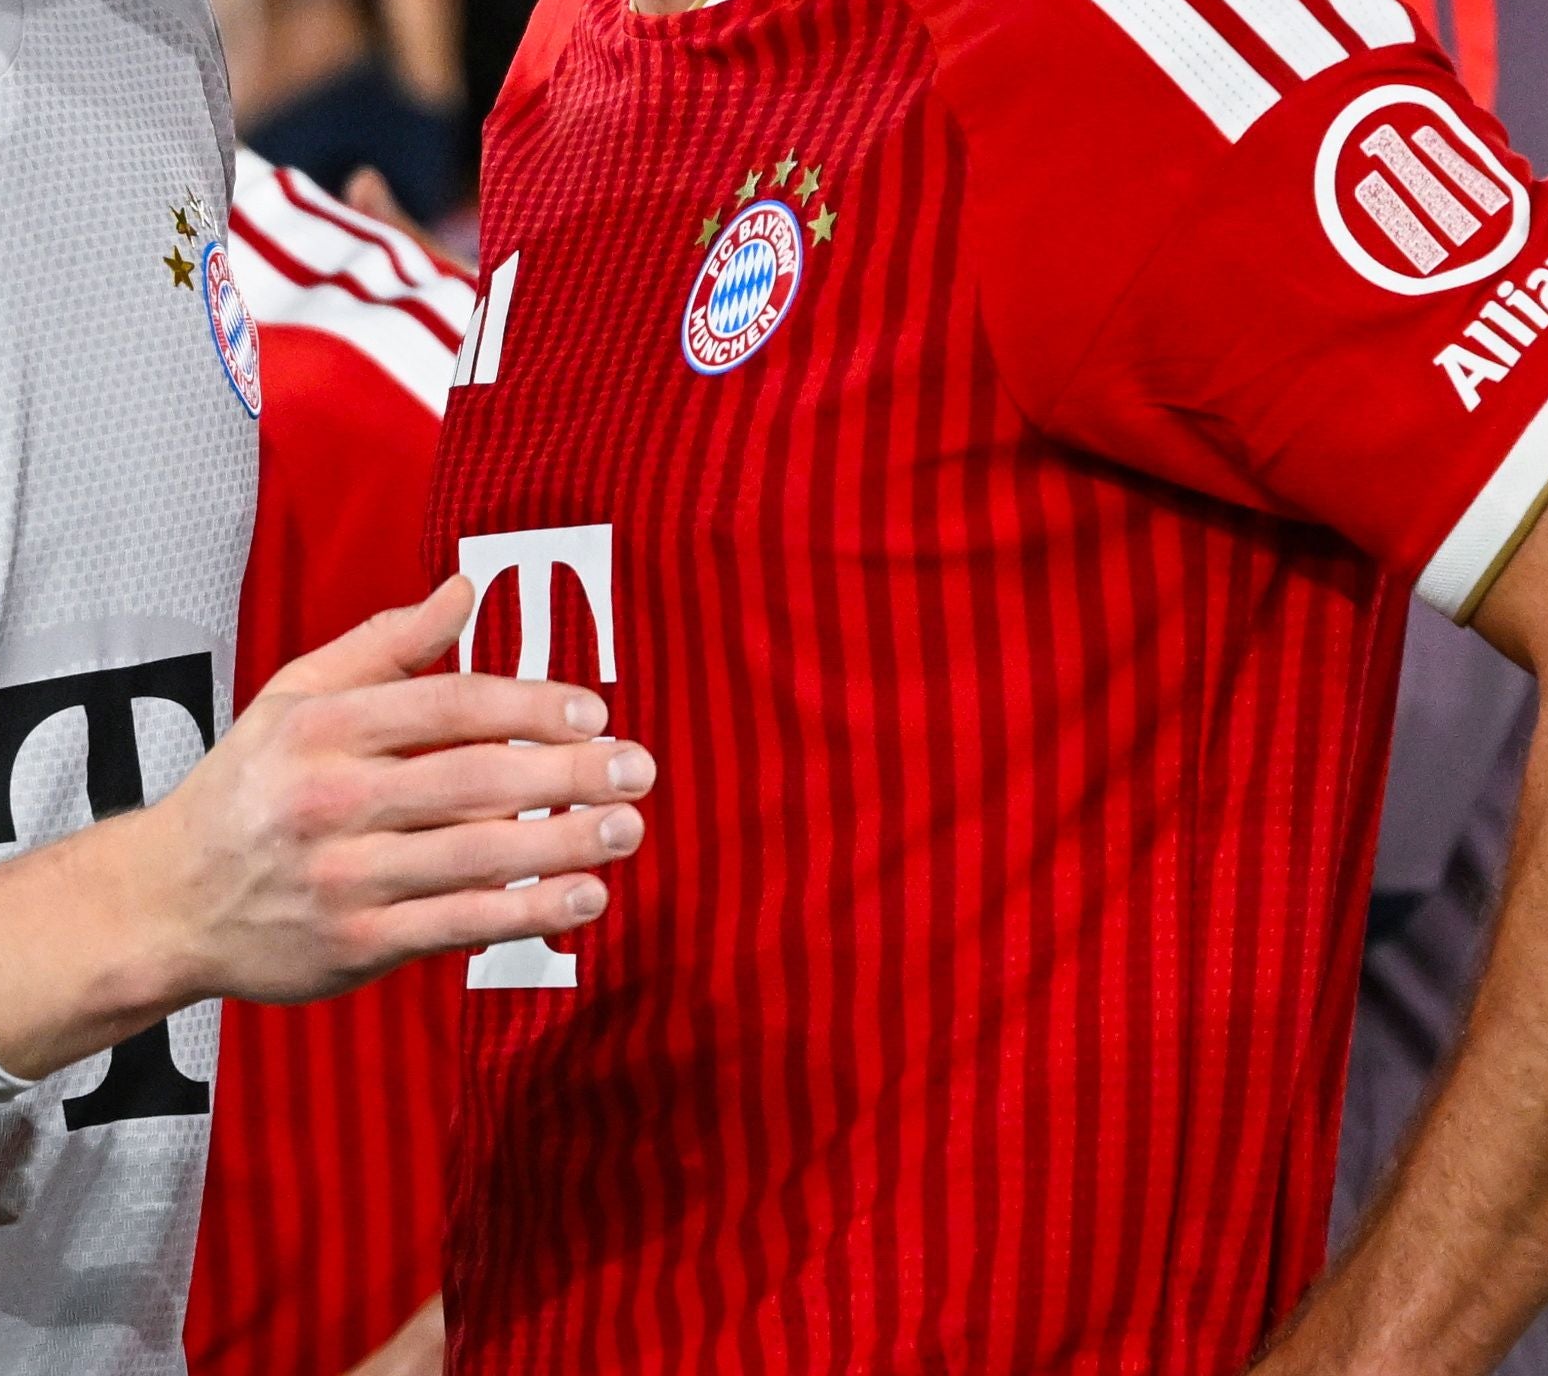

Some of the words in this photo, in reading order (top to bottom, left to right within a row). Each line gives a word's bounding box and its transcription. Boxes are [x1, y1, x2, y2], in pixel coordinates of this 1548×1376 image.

[707, 239, 734, 279] FC
[739, 213, 797, 277] BAYERN
[456, 523, 618, 990] T
